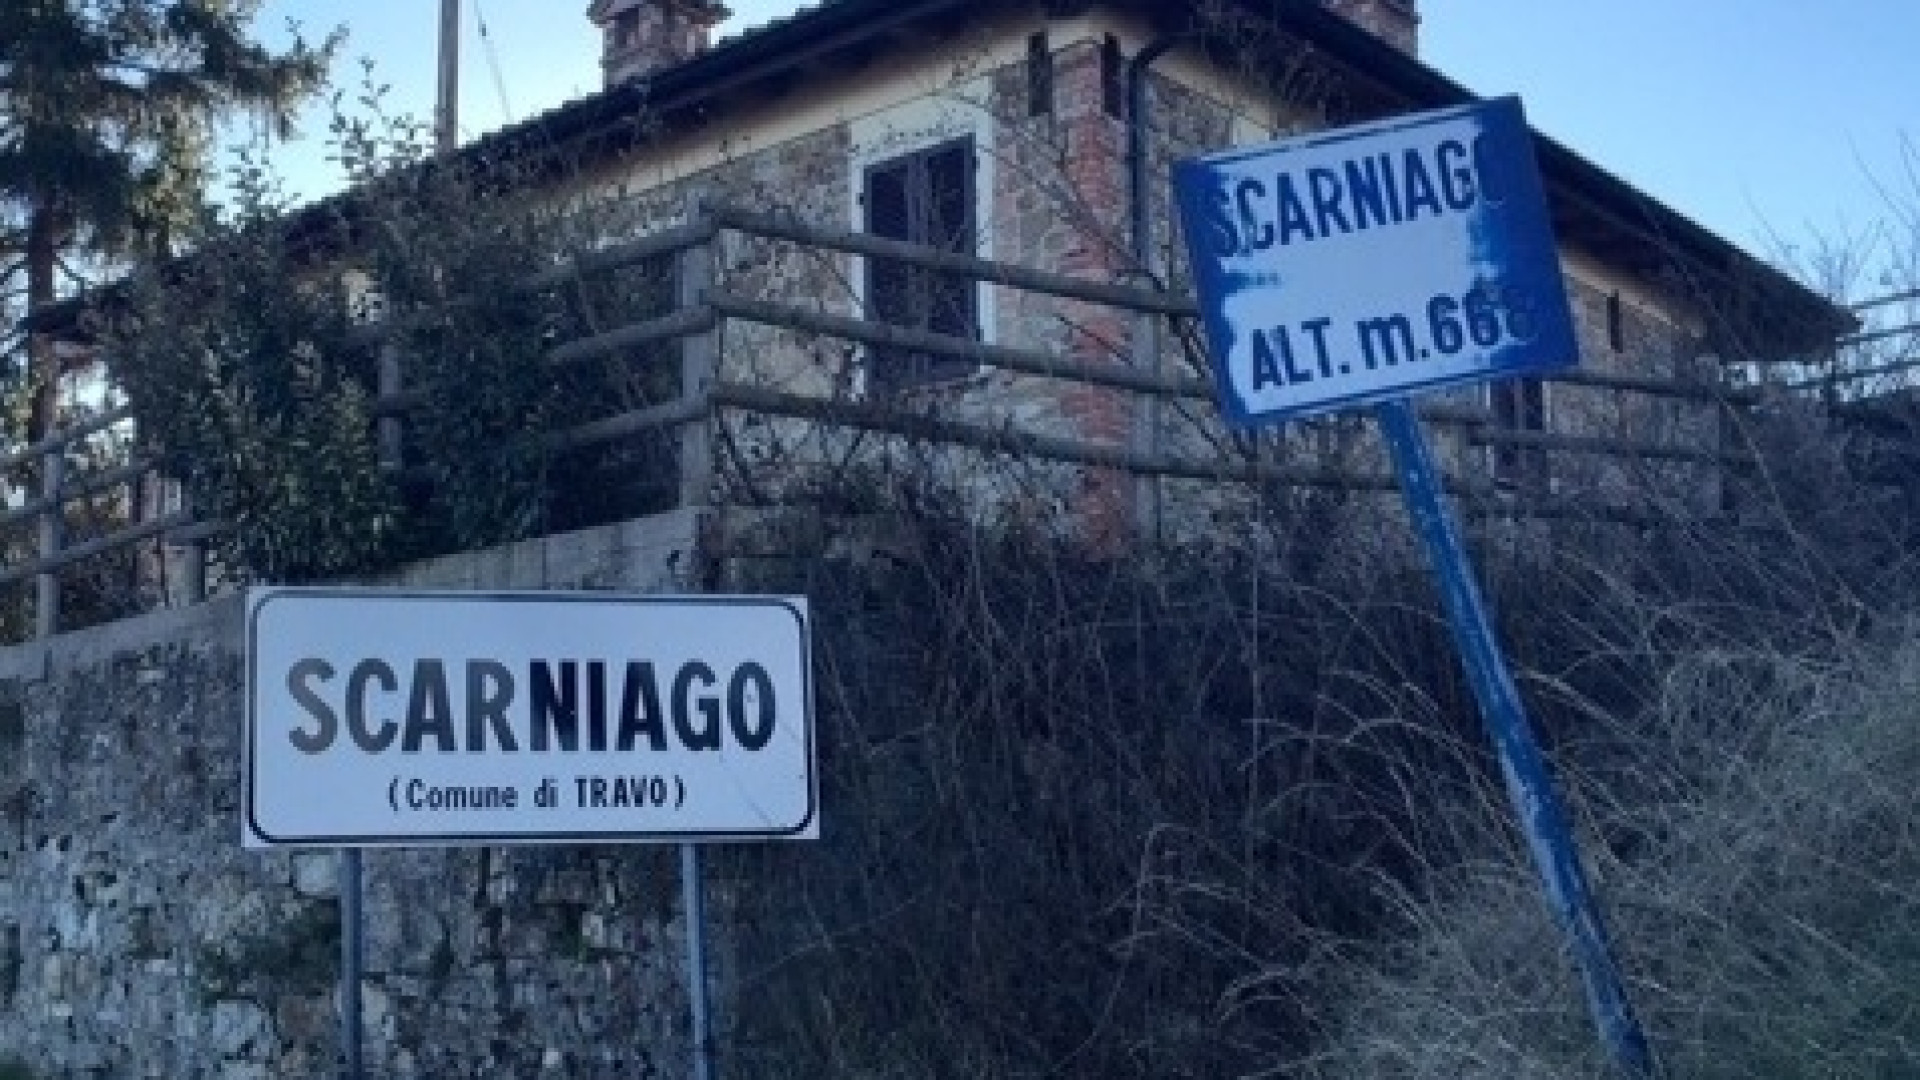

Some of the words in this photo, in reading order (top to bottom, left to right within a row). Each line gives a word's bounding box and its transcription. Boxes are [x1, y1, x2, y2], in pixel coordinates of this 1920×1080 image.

[1251, 317, 1351, 392] ALT.
[285, 657, 777, 755] SCARNIAGO
[388, 777, 518, 811] (Comune
[533, 777, 559, 808] di
[573, 775, 687, 808] TRAVO)
